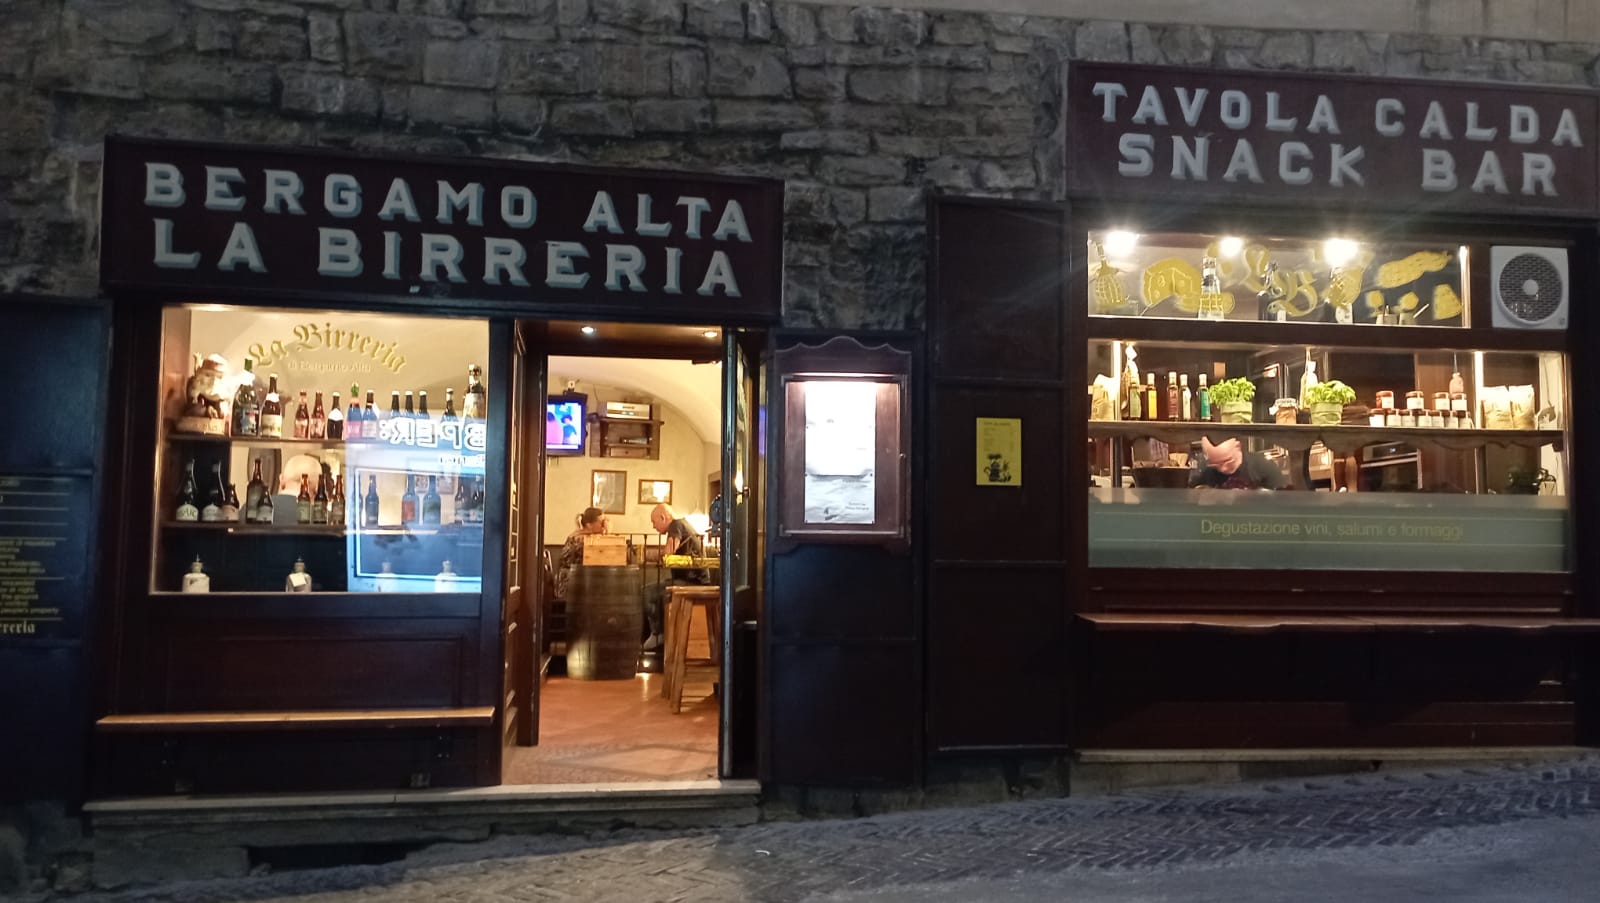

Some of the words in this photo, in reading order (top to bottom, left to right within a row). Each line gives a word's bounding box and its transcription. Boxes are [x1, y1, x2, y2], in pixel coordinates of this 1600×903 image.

[1092, 82, 1341, 135] TAVOLA
[1375, 97, 1584, 148] CALDA
[1117, 132, 1366, 187] SNACK
[1421, 148, 1559, 197] BAR
[143, 161, 537, 229] BERGAMO
[582, 190, 753, 242] ALTA
[153, 218, 268, 273] LA
[316, 226, 743, 298] BIRRERIA
[247, 339, 289, 368] La
[292, 321, 408, 375] Birreria
[1200, 519, 1300, 538] Degustazione
[1304, 521, 1333, 537] vini,
[1336, 522, 1384, 537] salumi
[1387, 526, 1397, 537] e
[1400, 522, 1465, 542] formaggi
